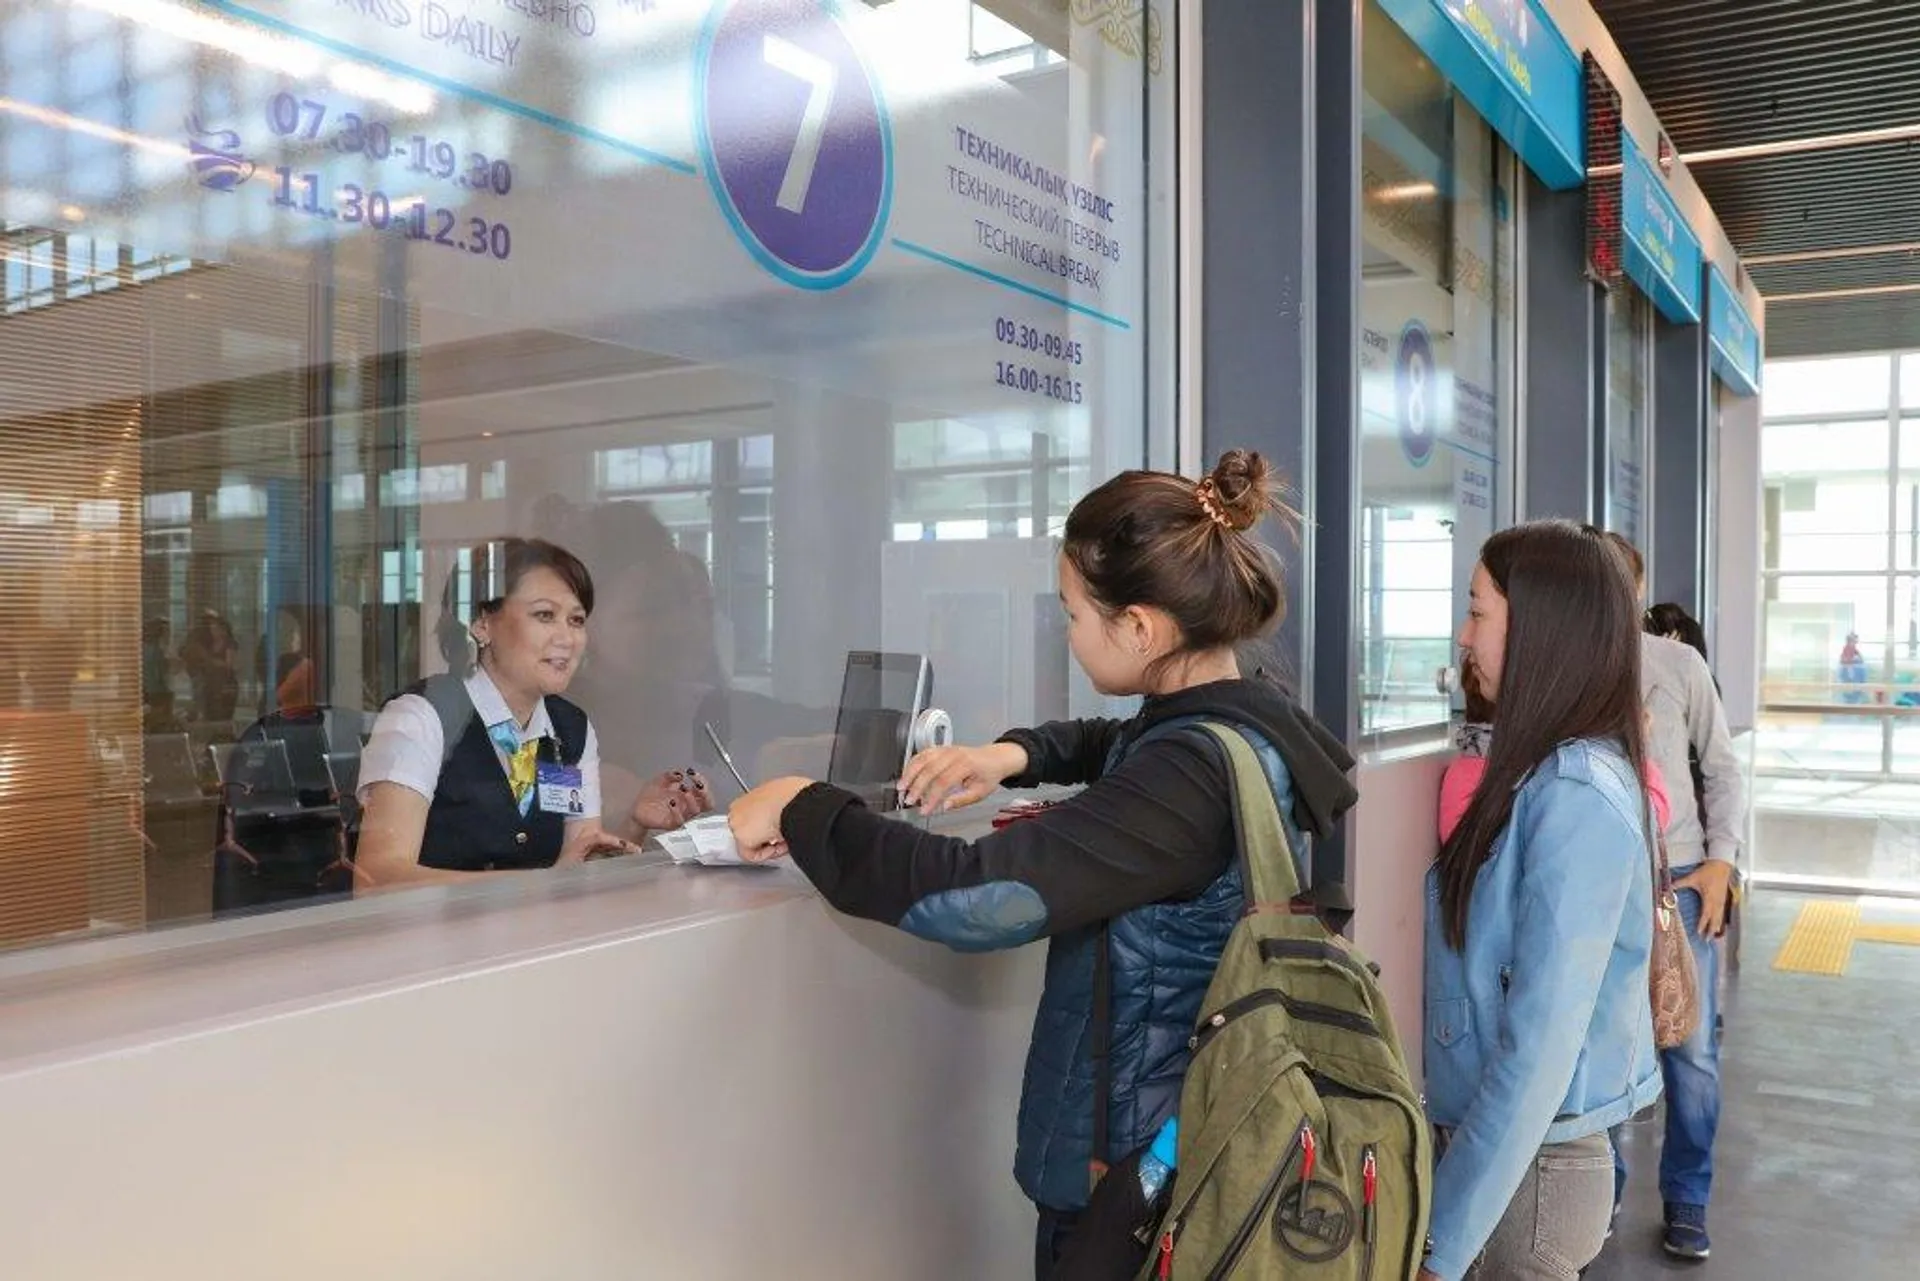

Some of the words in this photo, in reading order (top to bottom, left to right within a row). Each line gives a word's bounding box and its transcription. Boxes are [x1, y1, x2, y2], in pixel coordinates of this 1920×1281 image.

[422, 0, 520, 66] DAILY
[268, 92, 512, 196] 07.30-19.30
[763, 35, 833, 215] 7
[956, 126, 1069, 205] ТЕХНИКАЛЫҚ
[272, 165, 512, 261] 11.30-12.30
[948, 165, 1060, 235] ТЕХНИЧЕСКИЙ
[1063, 218, 1122, 263] ПЕРЕРЫВ
[975, 219, 1059, 275] TECHNICAL
[1059, 255, 1102, 293] BREAK
[995, 317, 1083, 365] 09.30-09.45
[995, 361, 1083, 405] 16.00-16.15
[1407, 351, 1426, 436] 8
